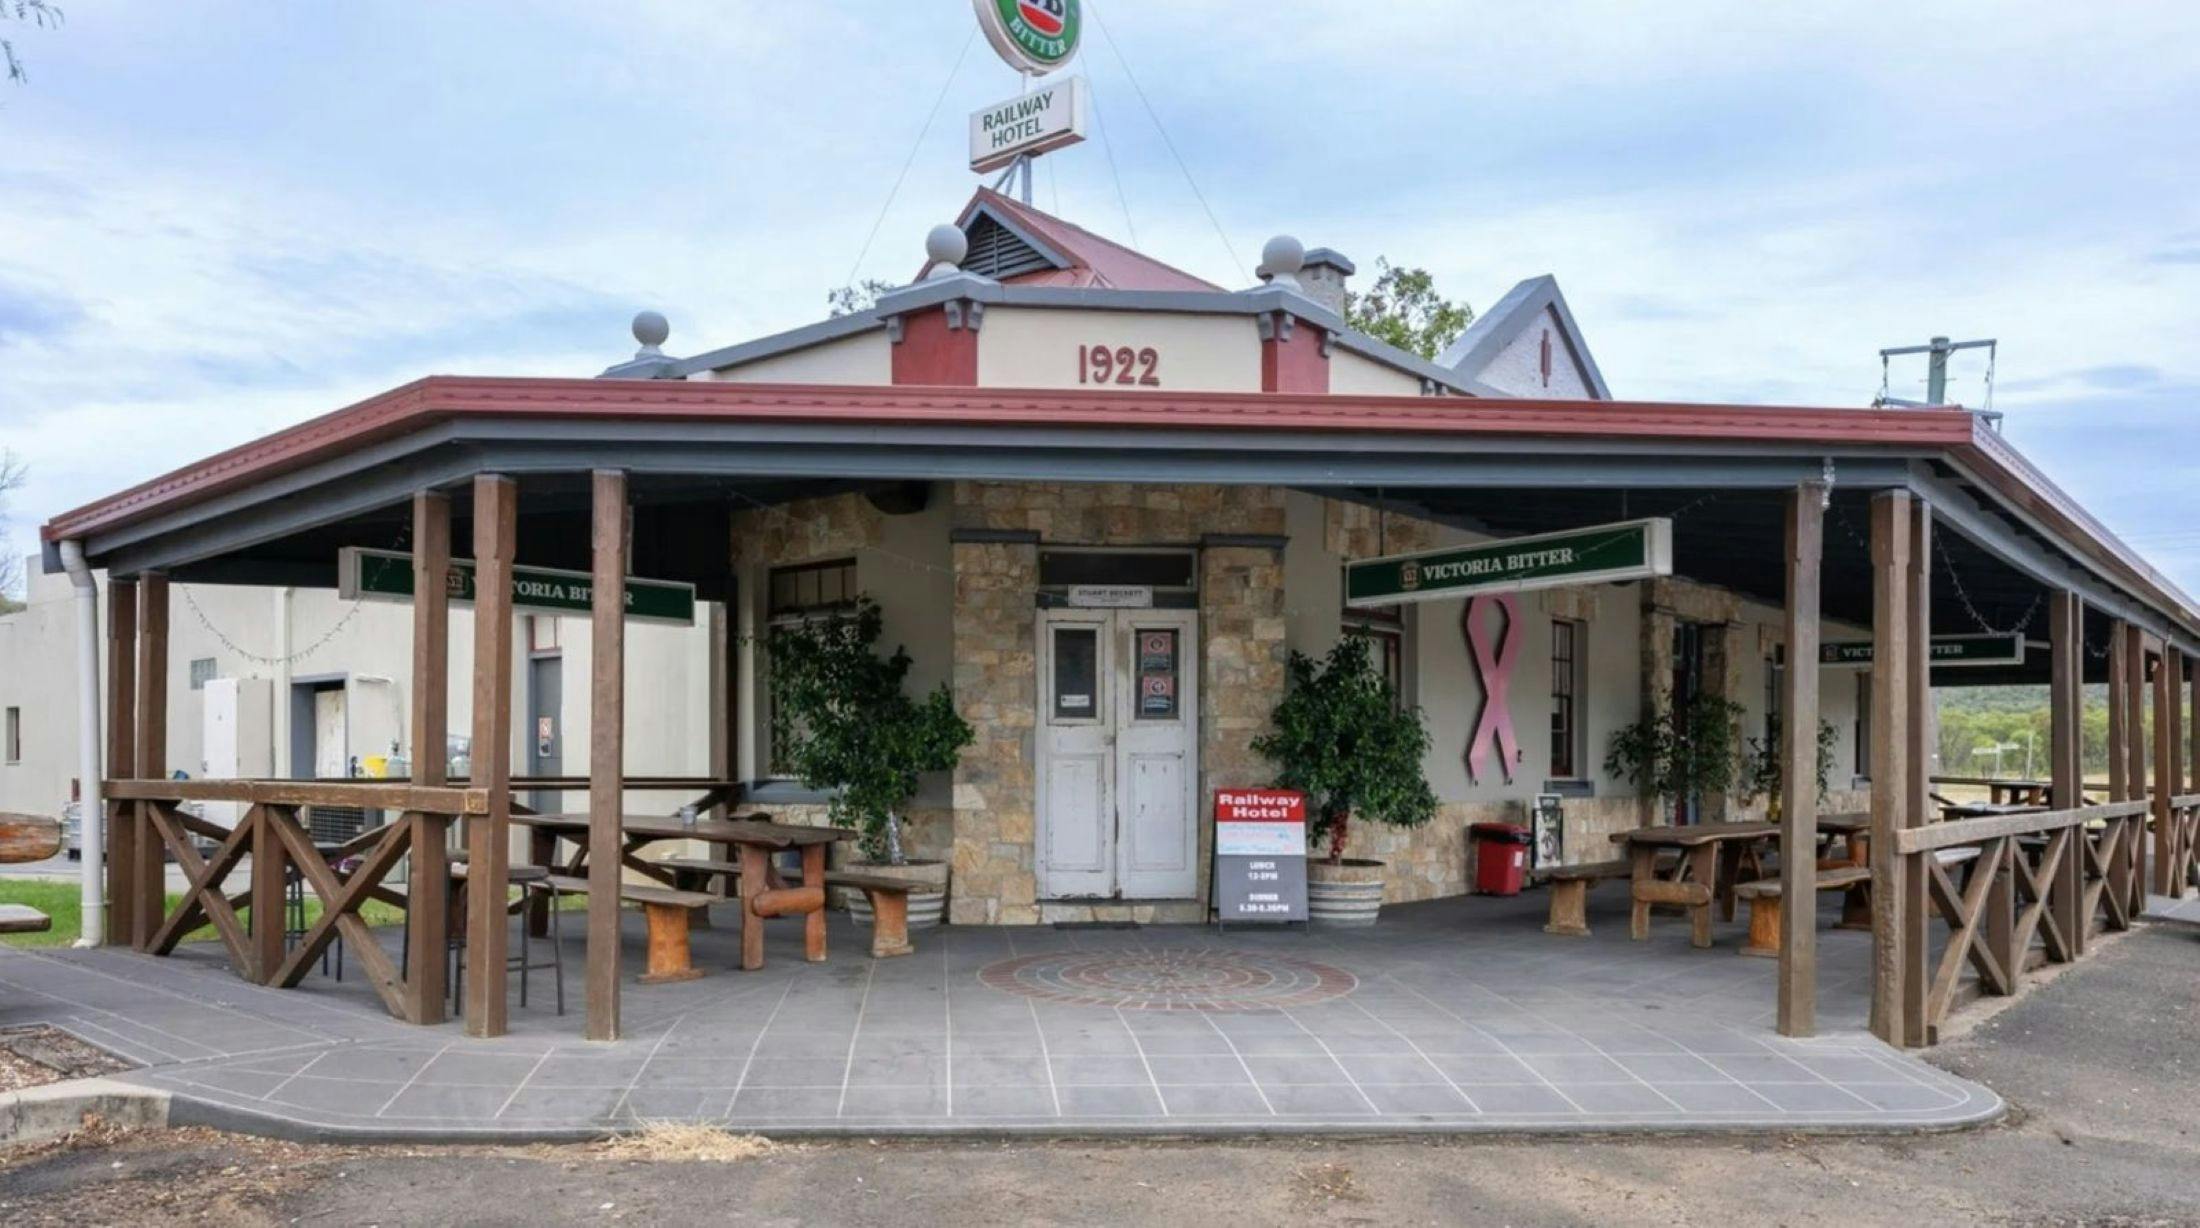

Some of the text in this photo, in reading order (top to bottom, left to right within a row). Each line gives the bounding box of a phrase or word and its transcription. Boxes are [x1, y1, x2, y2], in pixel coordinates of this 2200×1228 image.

[1009, 16, 1066, 56] BITTER
[983, 91, 1054, 131] RAILWAY
[991, 117, 1045, 148] HOTEL
[1079, 344, 1160, 387] 1922
[1422, 556, 1502, 582] VICTORIA
[1507, 547, 1573, 571] BITTER
[1218, 793, 1300, 808] Railway
[1232, 807, 1288, 819] Hotel
